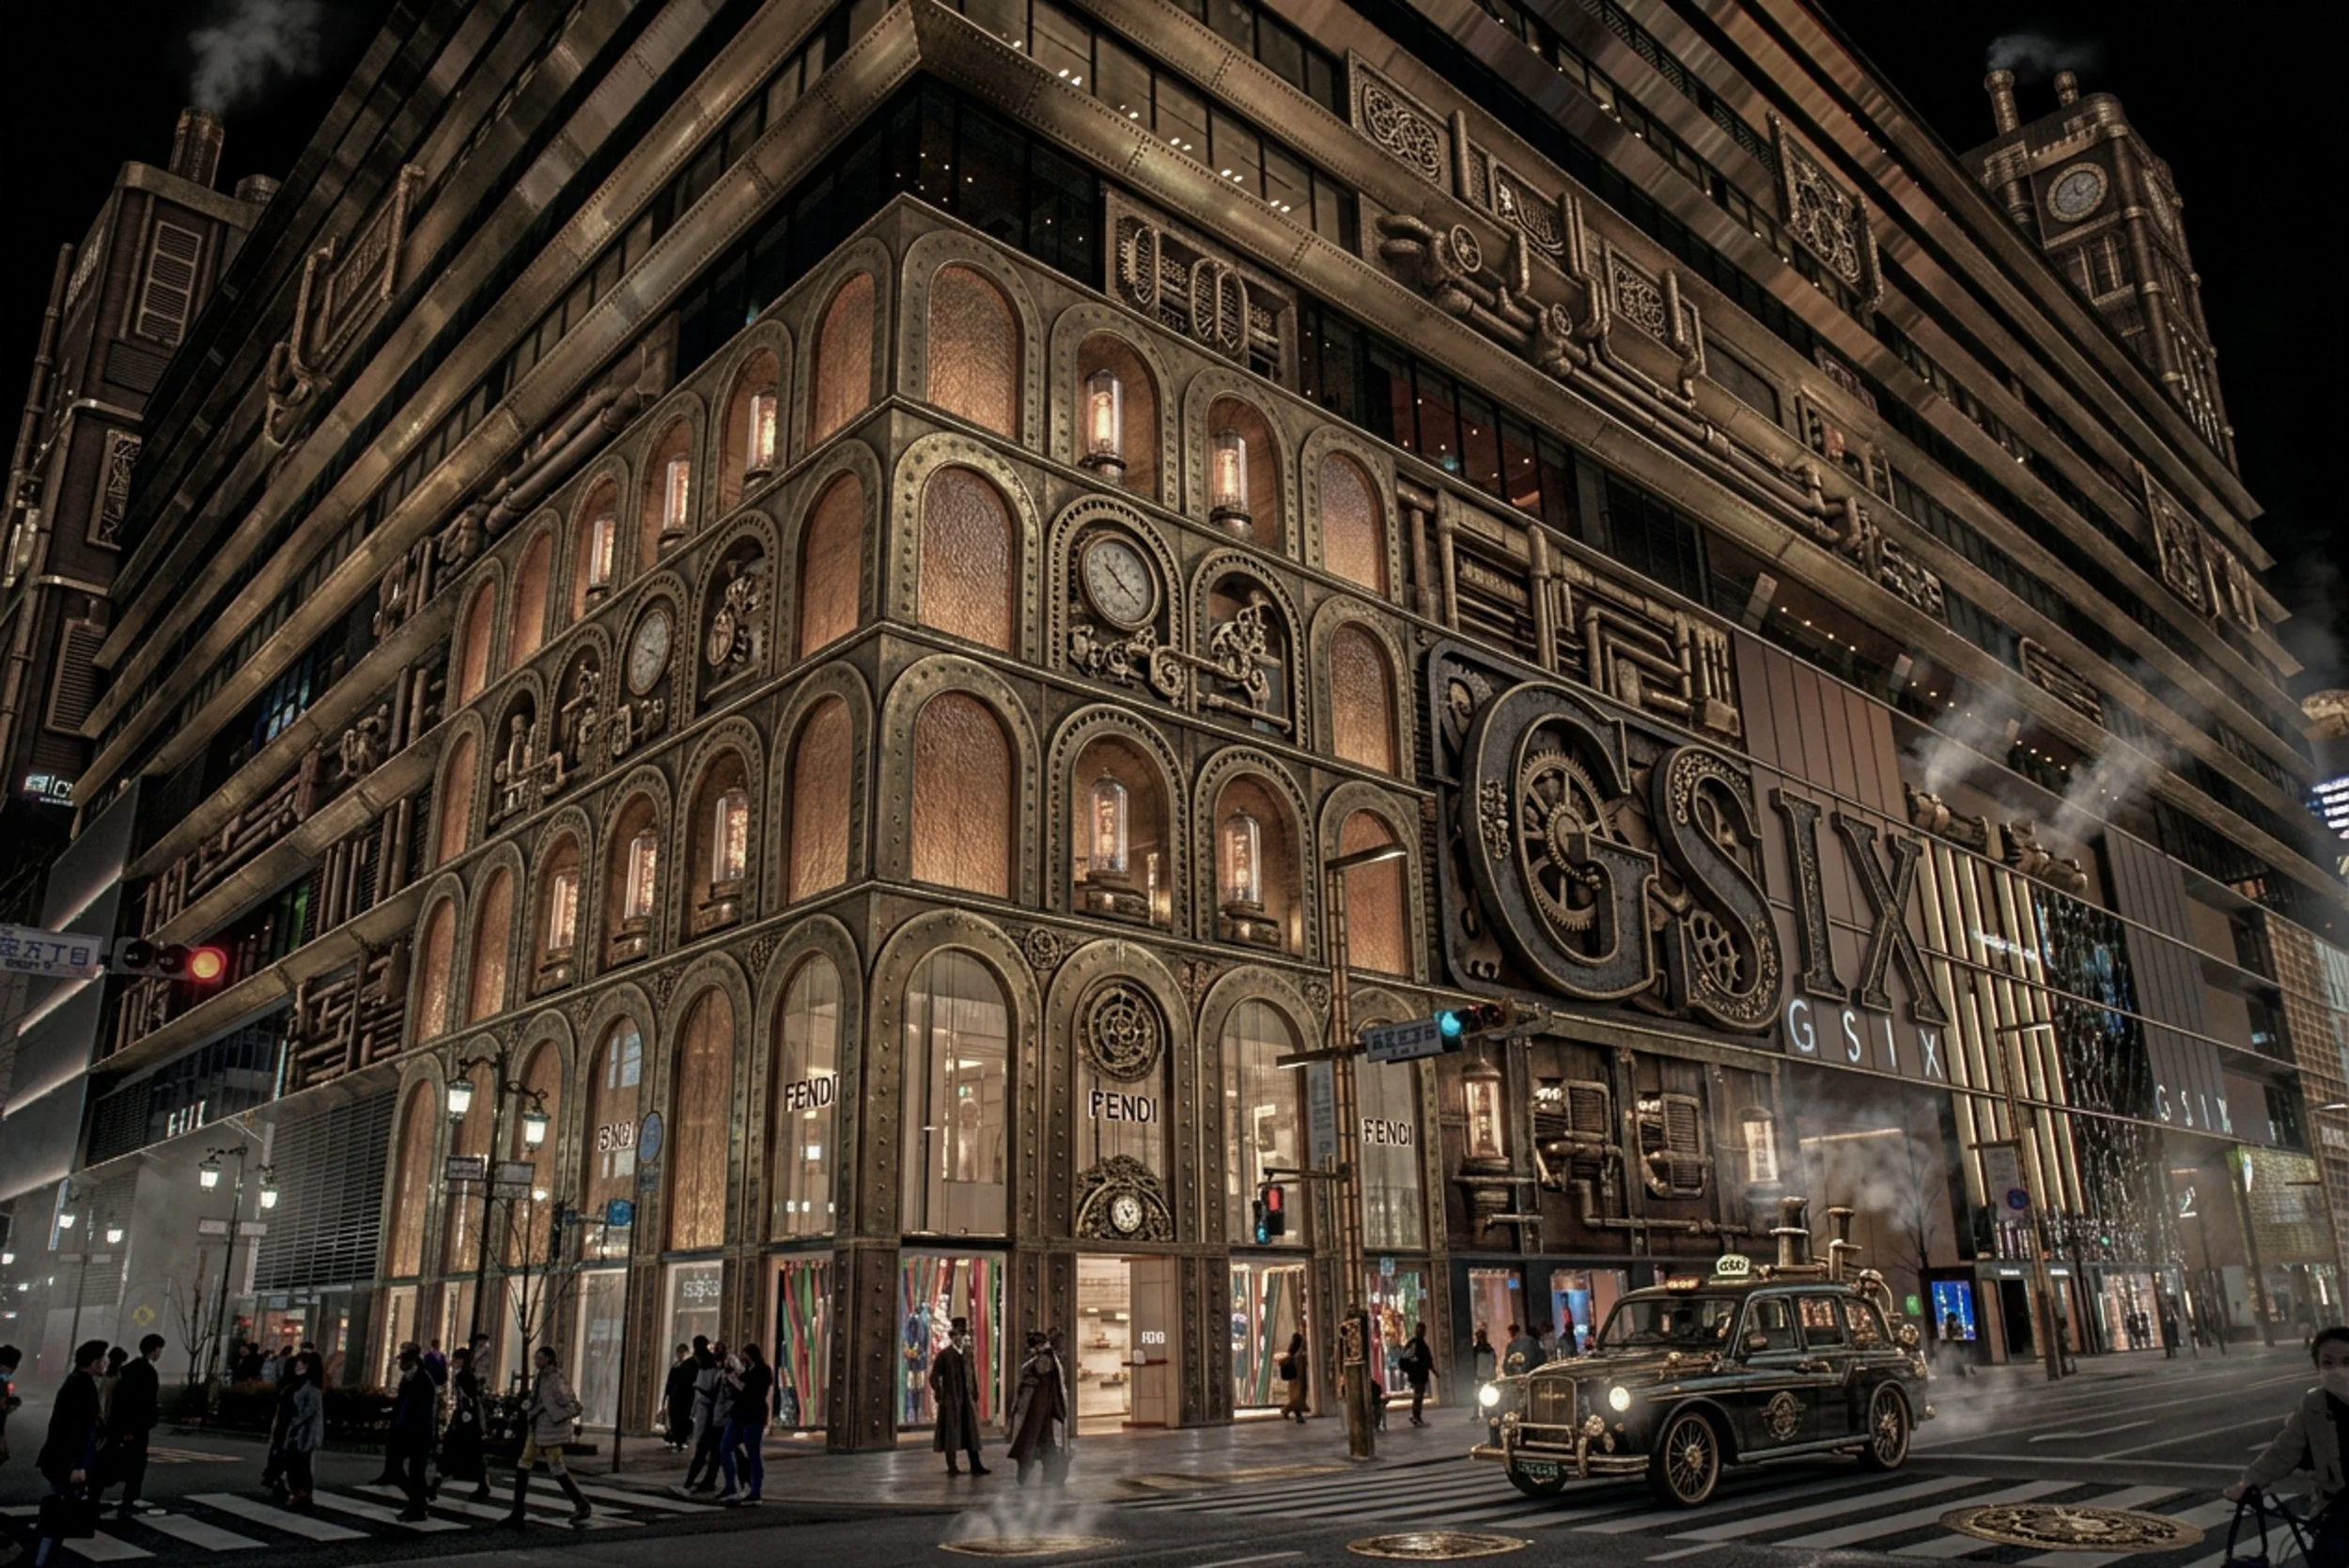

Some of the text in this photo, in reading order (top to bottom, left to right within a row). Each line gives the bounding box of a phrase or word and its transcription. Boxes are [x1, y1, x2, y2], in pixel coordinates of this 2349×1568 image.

[1460, 681, 1949, 1030] GSIX
[1788, 999, 1943, 1079] GSIX
[785, 1072, 839, 1111] FENDI
[1090, 1090, 1157, 1123] FENDI
[2155, 1084, 2232, 1135] GSIX
